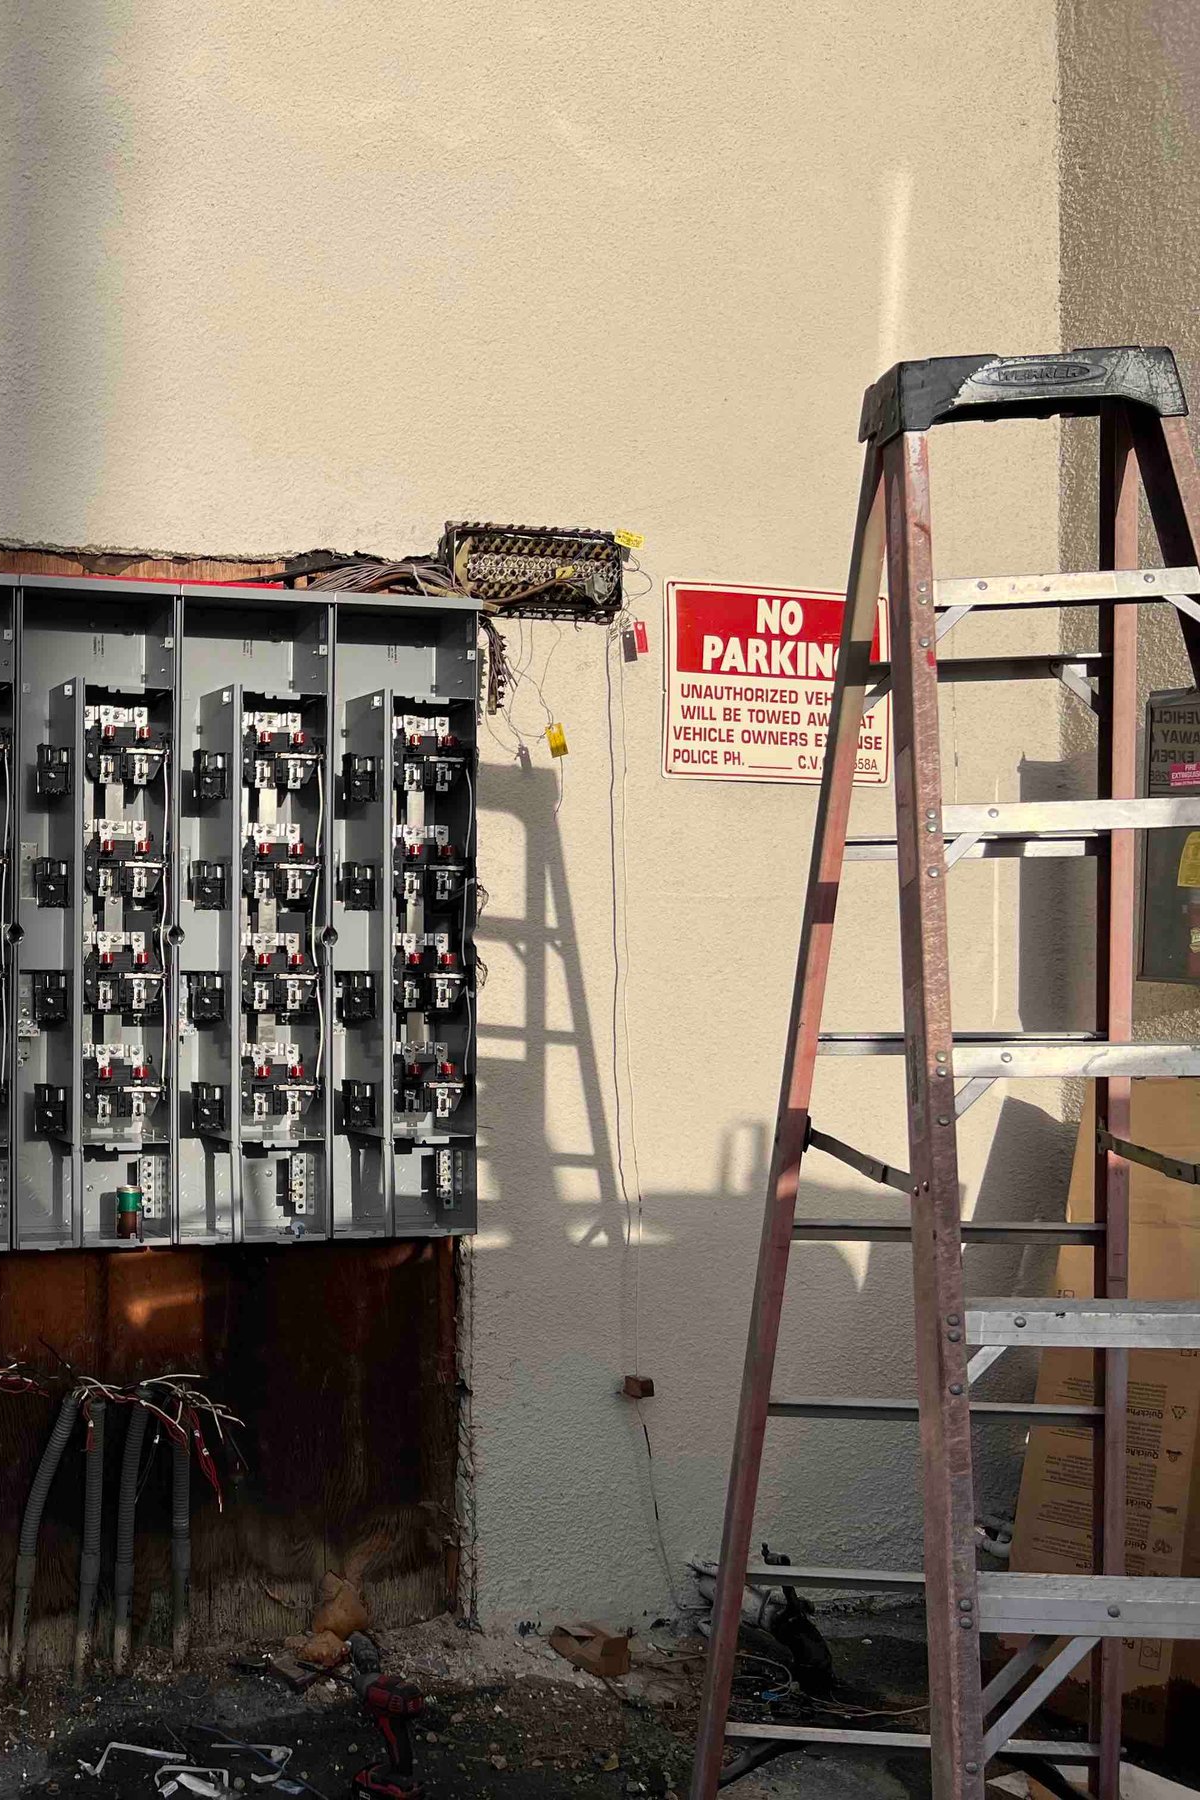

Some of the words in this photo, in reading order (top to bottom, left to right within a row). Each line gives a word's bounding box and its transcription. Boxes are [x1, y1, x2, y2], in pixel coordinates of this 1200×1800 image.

[997, 366, 1080, 382] WERNER
[756, 598, 803, 636] NO
[702, 635, 840, 678] PARKIN
[680, 683, 798, 704] UNAUTHORIZED
[805, 691, 832, 706] VEH
[681, 705, 717, 721] WILL
[723, 707, 741, 722] BE
[747, 709, 800, 725] TOWED
[807, 712, 830, 727] AW
[673, 726, 735, 743] VEHICLE
[741, 729, 808, 747] OWNERS
[672, 749, 718, 764] POLICE
[724, 751, 745, 766] PH.
[798, 755, 825, 770] C.V.
[853, 758, 878, 771] 58A
[1171, 770, 1200, 780] EXTINGUIS
